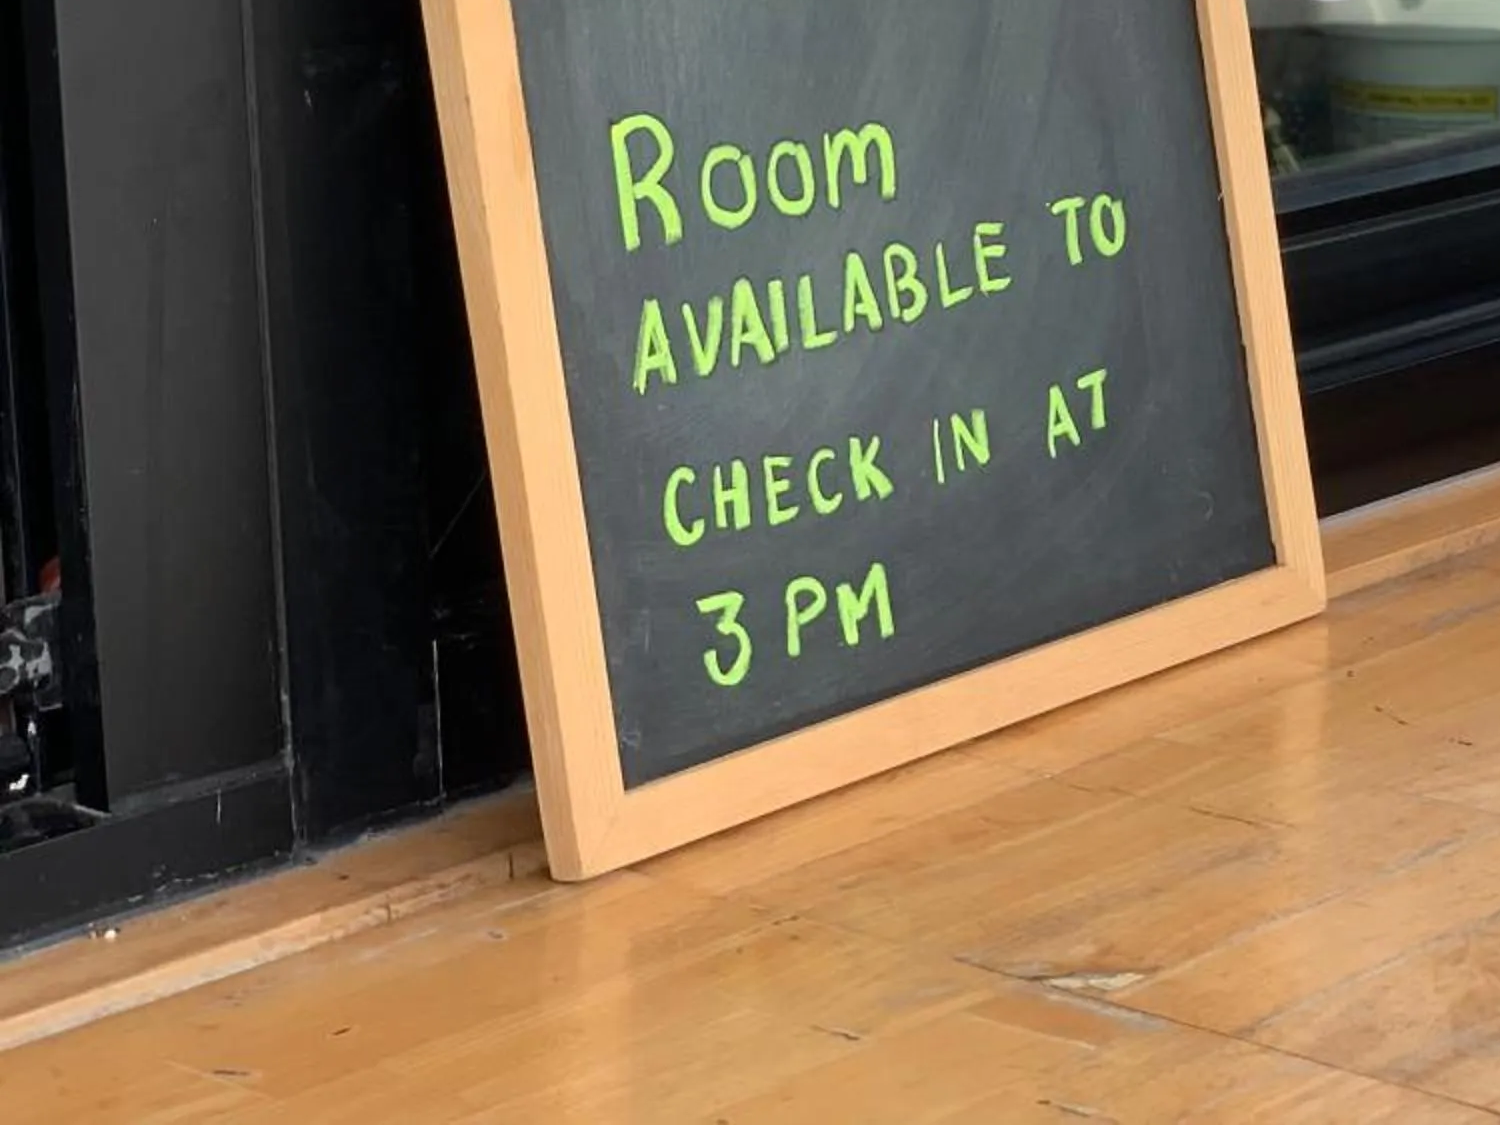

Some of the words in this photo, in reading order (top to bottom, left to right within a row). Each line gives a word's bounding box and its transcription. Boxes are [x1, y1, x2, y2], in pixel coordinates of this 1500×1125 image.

[609, 113, 897, 251] Room
[632, 221, 1012, 395] AVAILABLE
[1046, 192, 1127, 266] TO
[663, 435, 895, 547] CHECK
[932, 408, 991, 484] IN
[1046, 368, 1108, 459] AT
[696, 590, 753, 687] 3
[784, 562, 896, 656] PM
